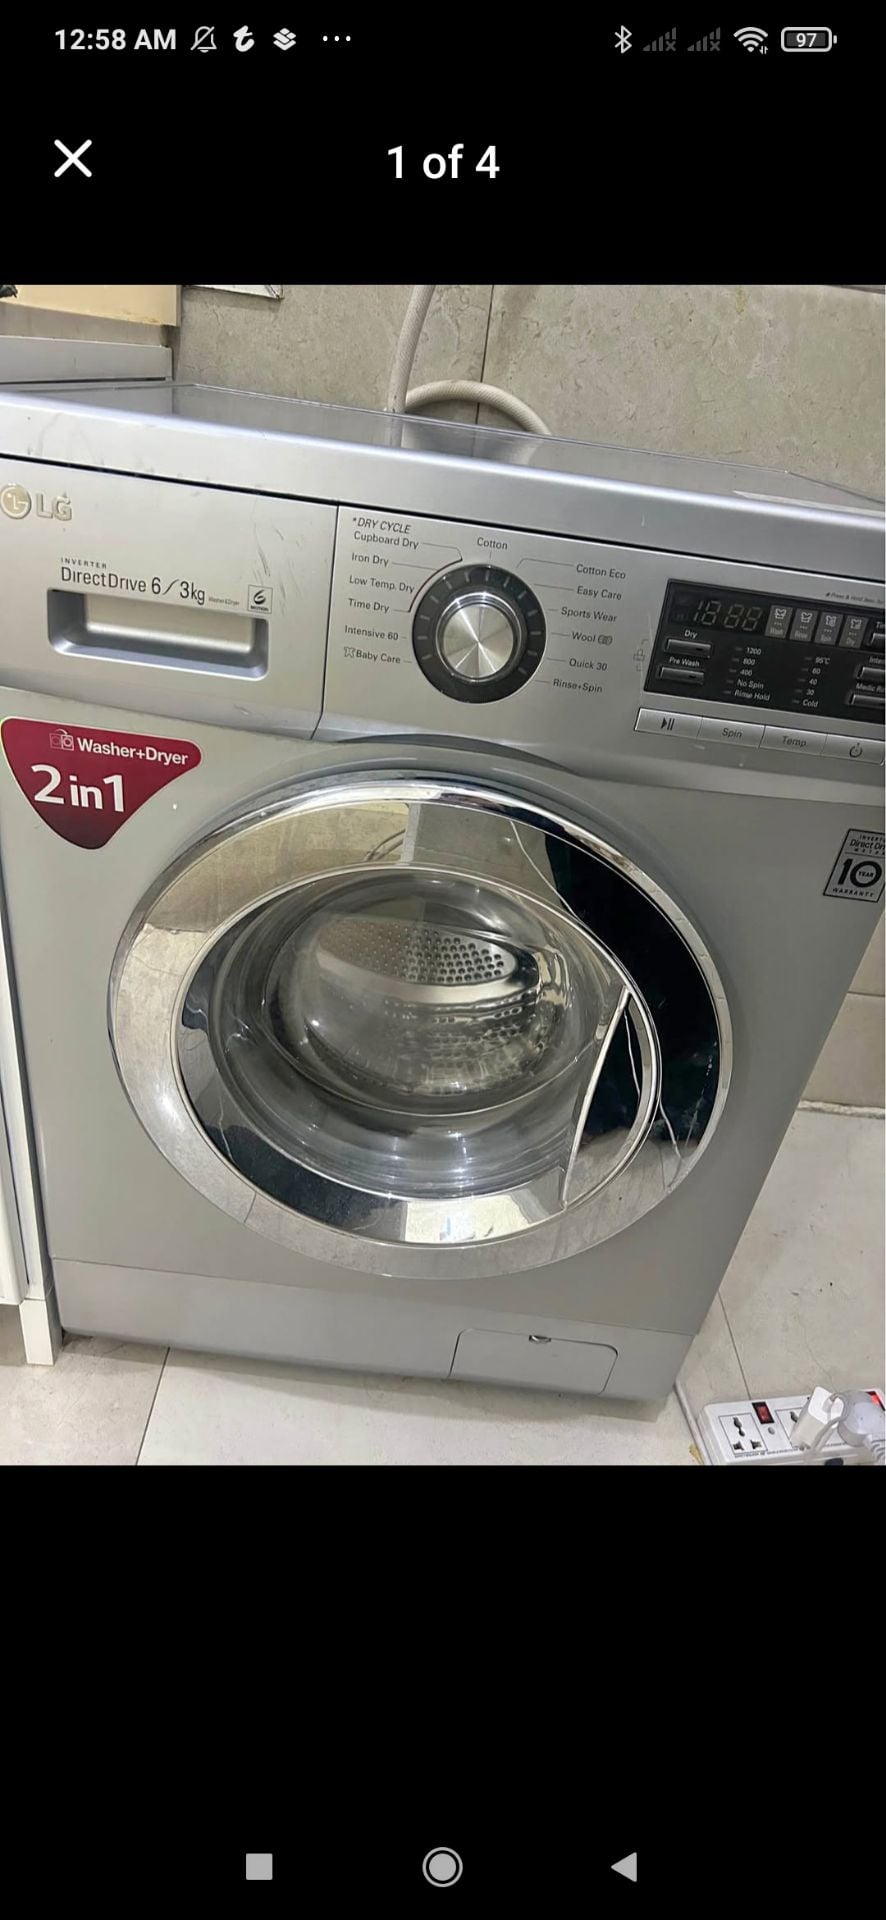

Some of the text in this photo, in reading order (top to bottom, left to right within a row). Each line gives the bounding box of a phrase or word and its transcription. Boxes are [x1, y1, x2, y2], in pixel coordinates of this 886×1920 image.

[36, 493, 72, 521] LG
[380, 520, 411, 534] CYCLE
[354, 532, 419, 550] Cupboard Dry
[477, 537, 508, 550] Cotton
[61, 557, 107, 569] INVERTER
[352, 553, 389, 567] Iron Dry
[576, 564, 626, 580] Cotton Eco
[349, 575, 415, 594] Low Temp. Dry
[577, 586, 622, 600] Easy Care
[349, 599, 390, 613] Time Dry
[561, 607, 618, 622] Sports Wear
[344, 625, 399, 641] Intensive 60
[572, 631, 596, 643] Wool
[684, 629, 698, 639] Dry
[355, 649, 401, 664] Baby Care
[746, 647, 762, 655] 1200
[569, 658, 608, 671] Quick 30
[669, 656, 700, 667] Pre Wash
[740, 668, 753, 676] 400
[553, 678, 603, 694] Rinse+Spin
[737, 679, 764, 690] No Spin
[734, 689, 770, 701] Rinse Hold
[802, 699, 819, 708] Cold
[721, 727, 743, 739] Spin
[782, 735, 807, 748] Temp
[77, 737, 188, 765] Washer+Dryer
[838, 859, 882, 888] 10
